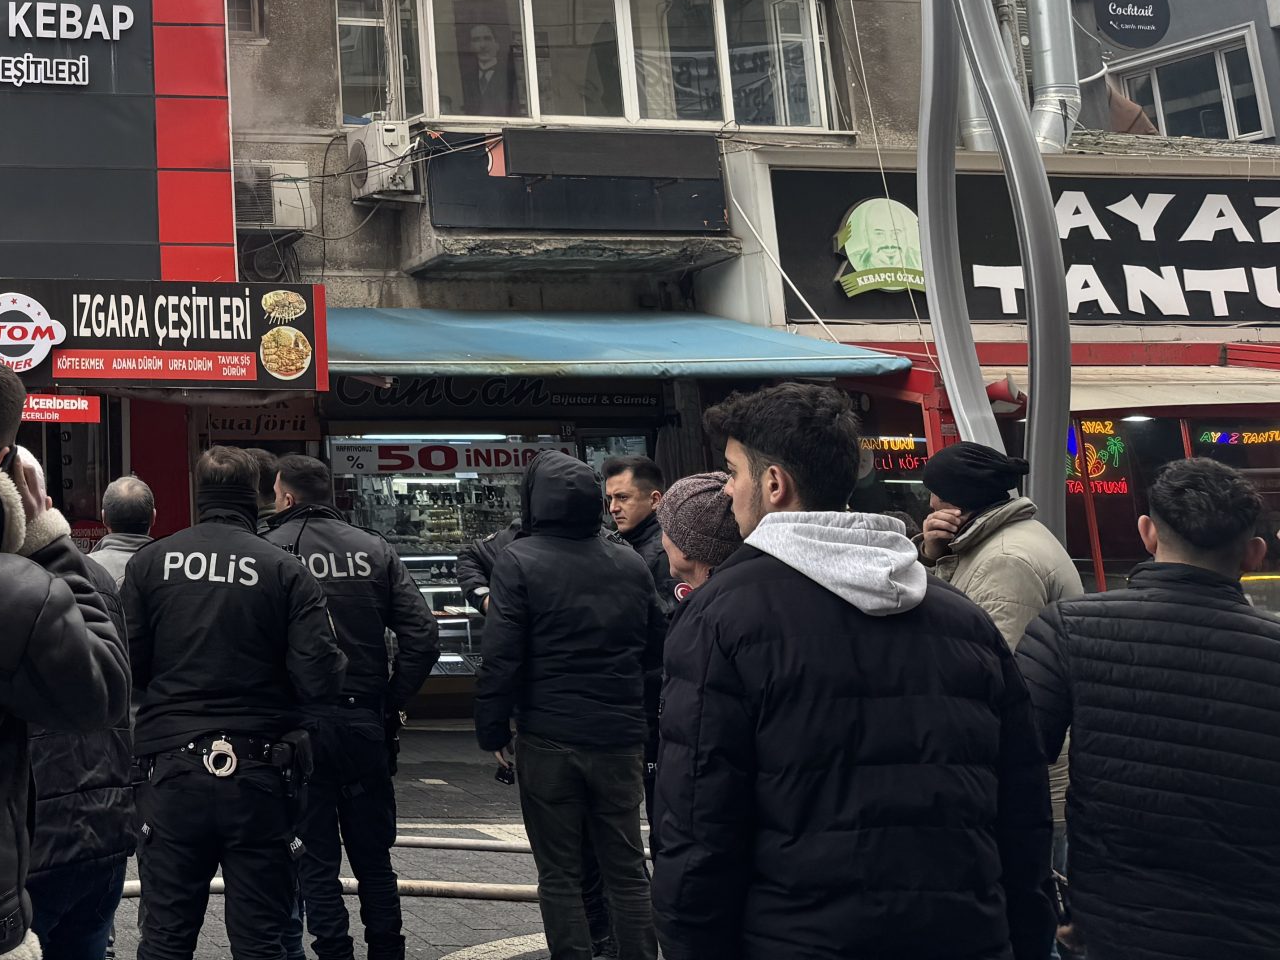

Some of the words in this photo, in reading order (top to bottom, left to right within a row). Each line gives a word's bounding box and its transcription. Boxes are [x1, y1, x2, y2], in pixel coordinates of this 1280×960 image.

[1108, 2, 1154, 17] Cocktail
[8, 1, 134, 41] KEBAP
[856, 272, 895, 286] KEBAPÇI
[73, 294, 149, 338] IZGARA
[154, 286, 252, 348] ÇEŞİTLERİ
[57, 355, 80, 370] KÖFTE
[81, 358, 104, 370] EKMEK
[112, 358, 137, 370] ADANA
[138, 355, 163, 371] DÜRÜM
[169, 358, 186, 371] URFA
[188, 357, 213, 371] DÜRÜM
[217, 355, 239, 365] TAVUK
[240, 354, 251, 366] ŞİŞ
[223, 366, 246, 376] DÜRÜM
[29, 396, 89, 410] İÇERİDEDİR
[601, 394, 610, 404] &
[21, 411, 60, 420] EÇERLİDİR
[205, 414, 306, 435] kuaförü
[858, 433, 915, 451] ANTUNİ
[1199, 431, 1240, 445] AYAZ
[346, 455, 364, 470] %
[377, 445, 459, 472] 50
[898, 453, 928, 470] KÖFT
[301, 551, 372, 579] OLİS
